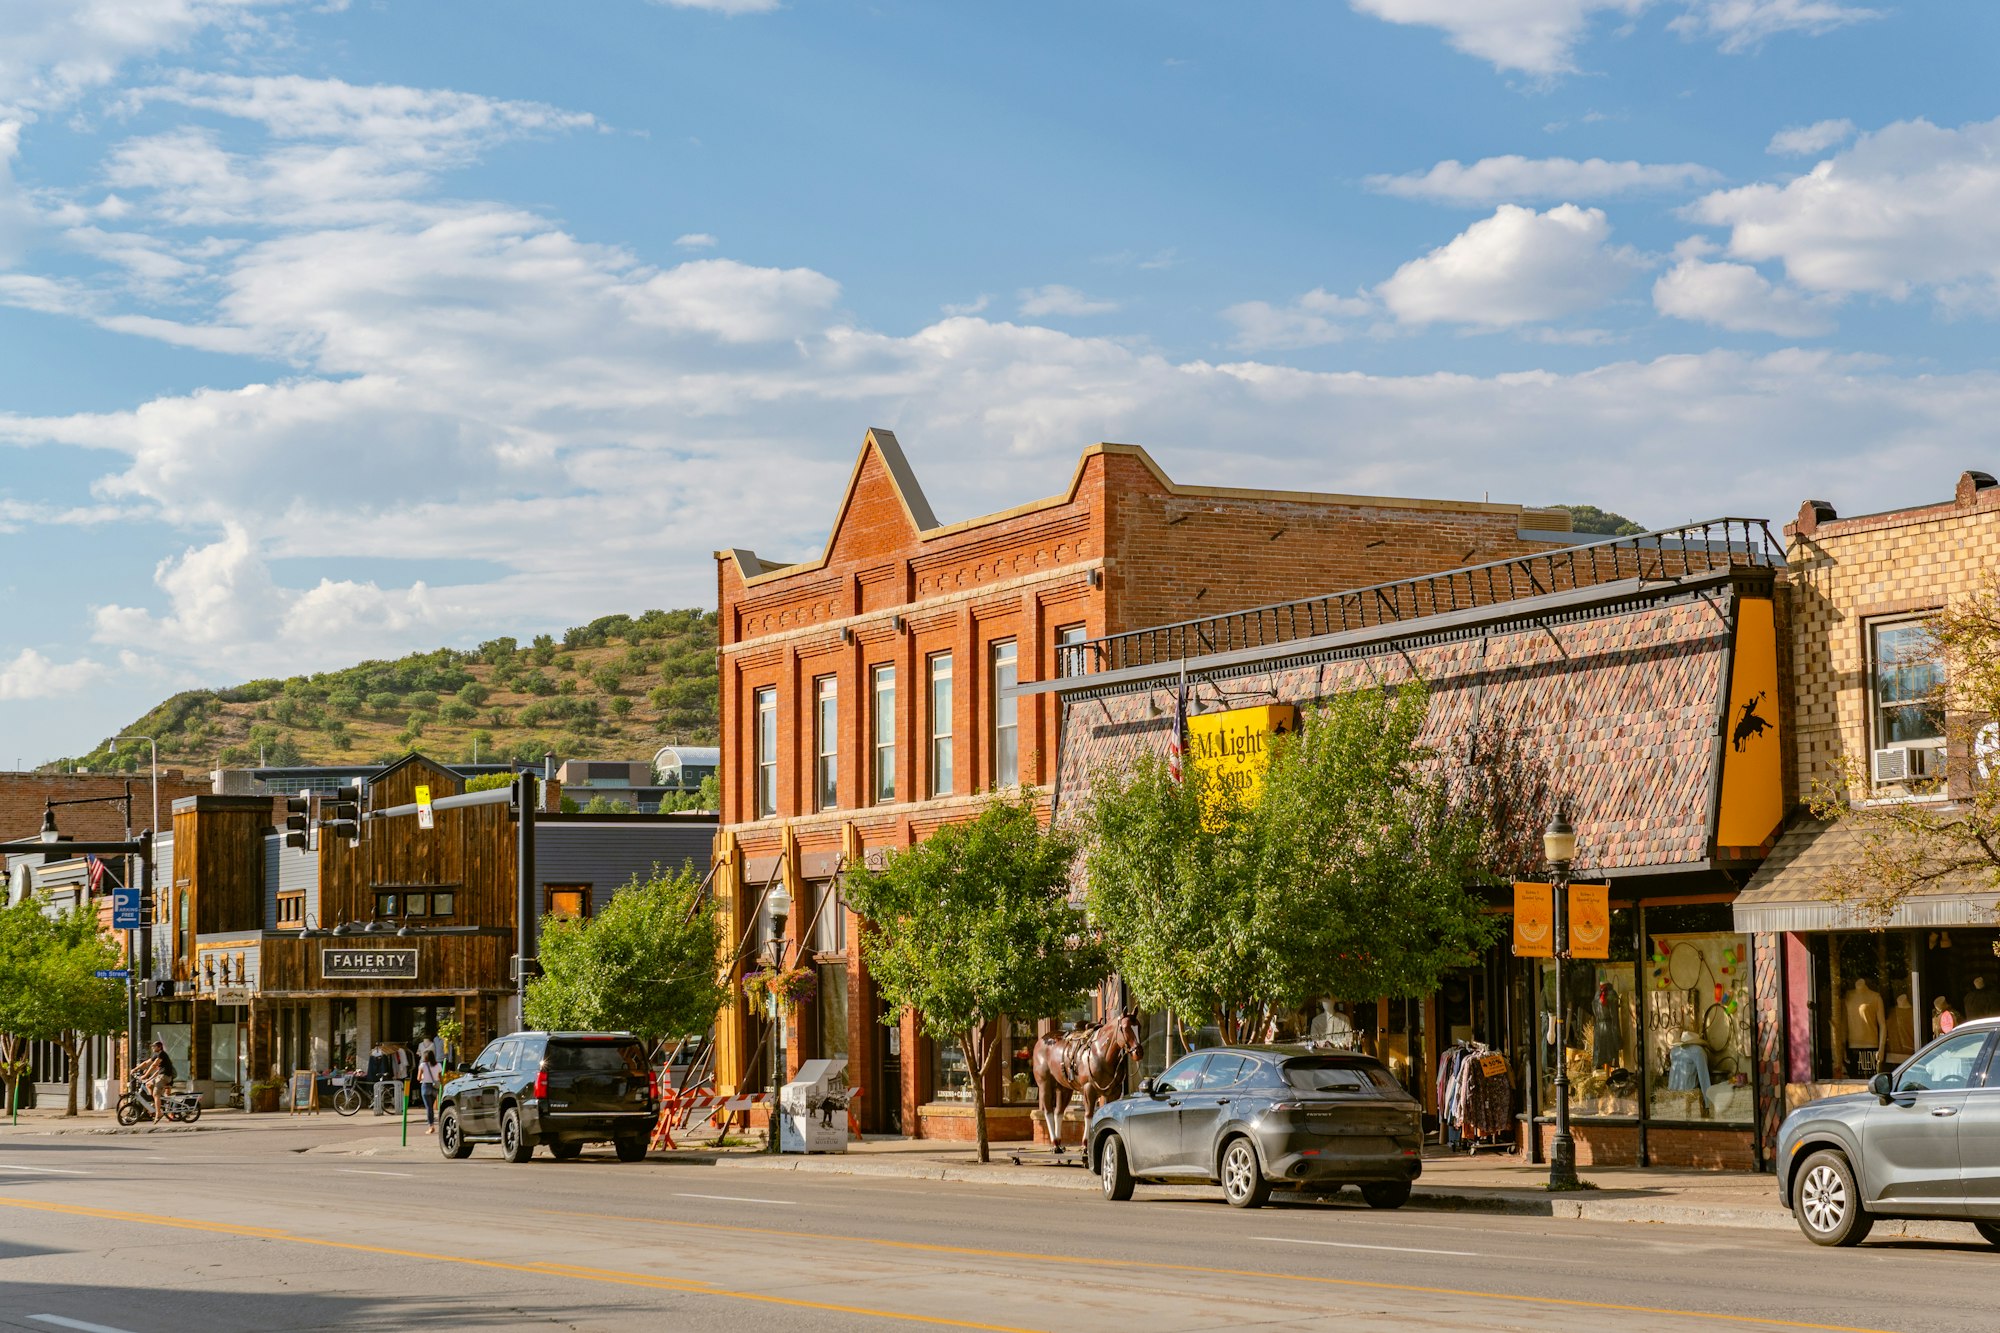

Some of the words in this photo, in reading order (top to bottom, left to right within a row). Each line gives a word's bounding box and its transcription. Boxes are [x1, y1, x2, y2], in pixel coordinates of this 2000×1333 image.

[1220, 725, 1262, 764] Light
[1216, 763, 1253, 792] Sons
[334, 955, 405, 966] FAHERTY
